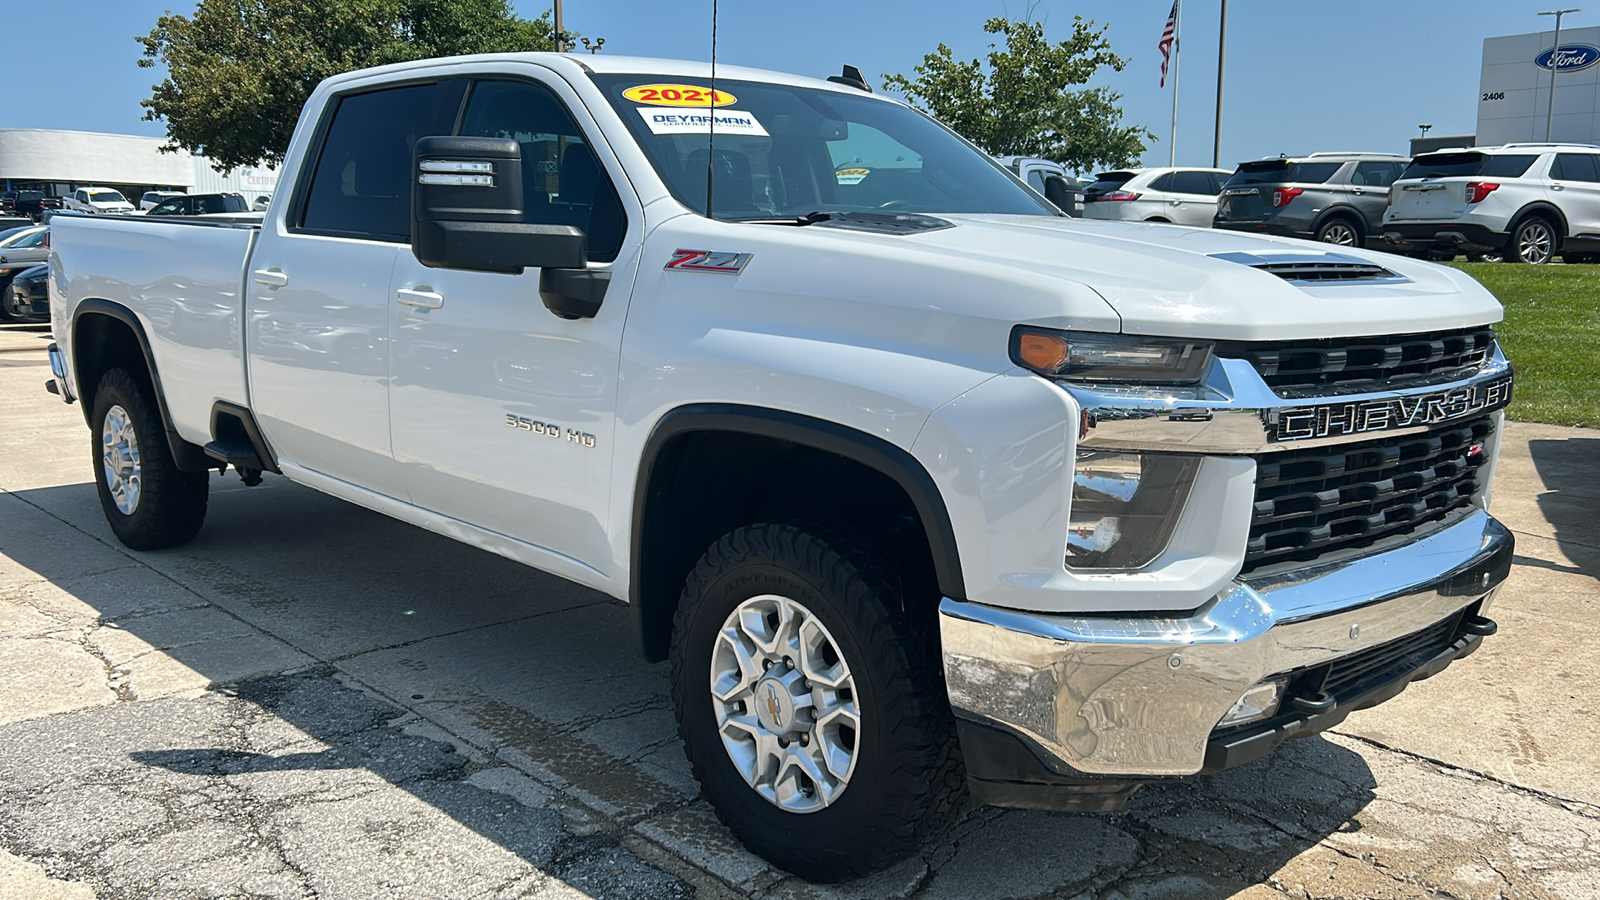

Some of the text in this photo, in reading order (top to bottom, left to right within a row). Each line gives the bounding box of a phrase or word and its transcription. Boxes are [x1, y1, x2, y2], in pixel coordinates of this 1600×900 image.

[1547, 50, 1587, 67] Ford
[638, 89, 721, 103] 2021
[1482, 92, 1505, 101] 2406
[653, 114, 751, 126] DEYARMAN
[246, 175, 277, 186] CERTIFIE
[663, 248, 755, 276] Z71
[1277, 376, 1513, 441] CHEVROLET
[506, 413, 596, 448] 3500 HD
